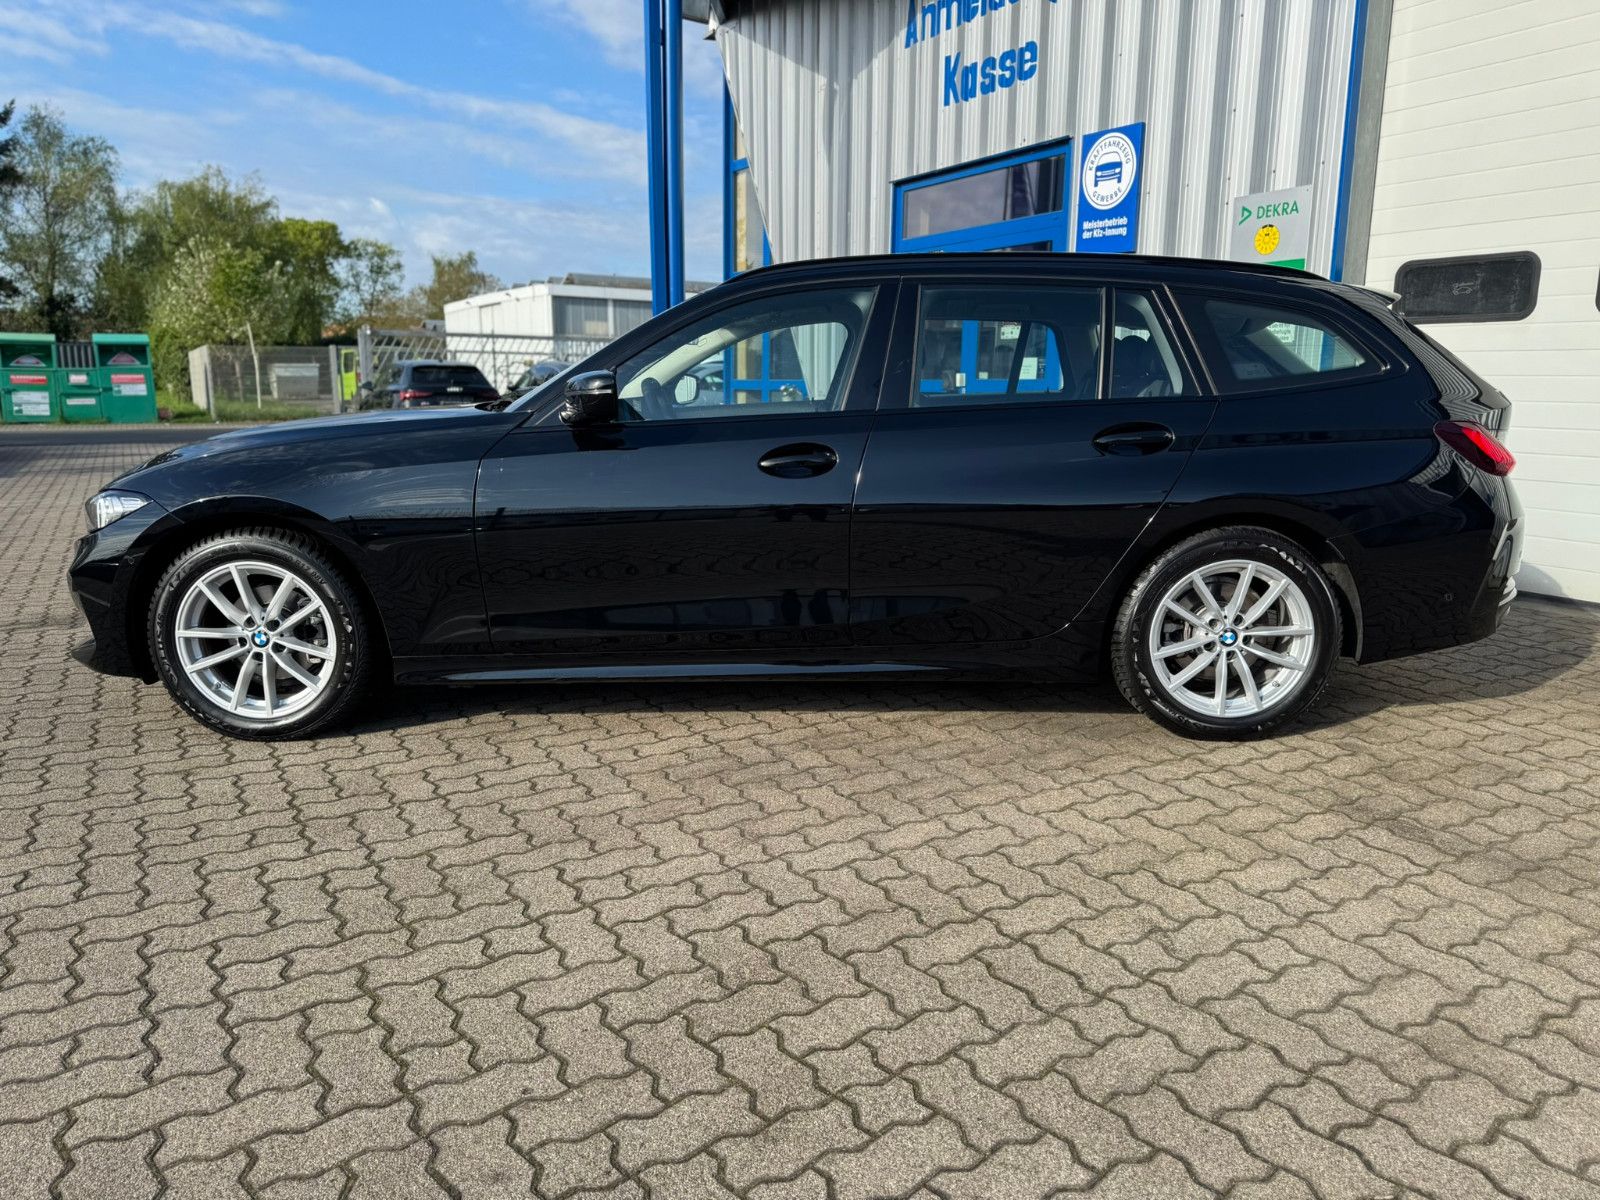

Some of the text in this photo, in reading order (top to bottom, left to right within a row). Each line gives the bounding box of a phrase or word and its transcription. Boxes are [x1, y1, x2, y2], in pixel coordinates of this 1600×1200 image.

[943, 41, 1038, 107] Kasse
[1089, 140, 1131, 171] KRAFTFAHRZEUG
[1093, 186, 1122, 202] GEWERBE
[1257, 200, 1299, 219] DEKRA
[1082, 216, 1128, 230] Meisterbetrieb
[1082, 230, 1093, 239] der
